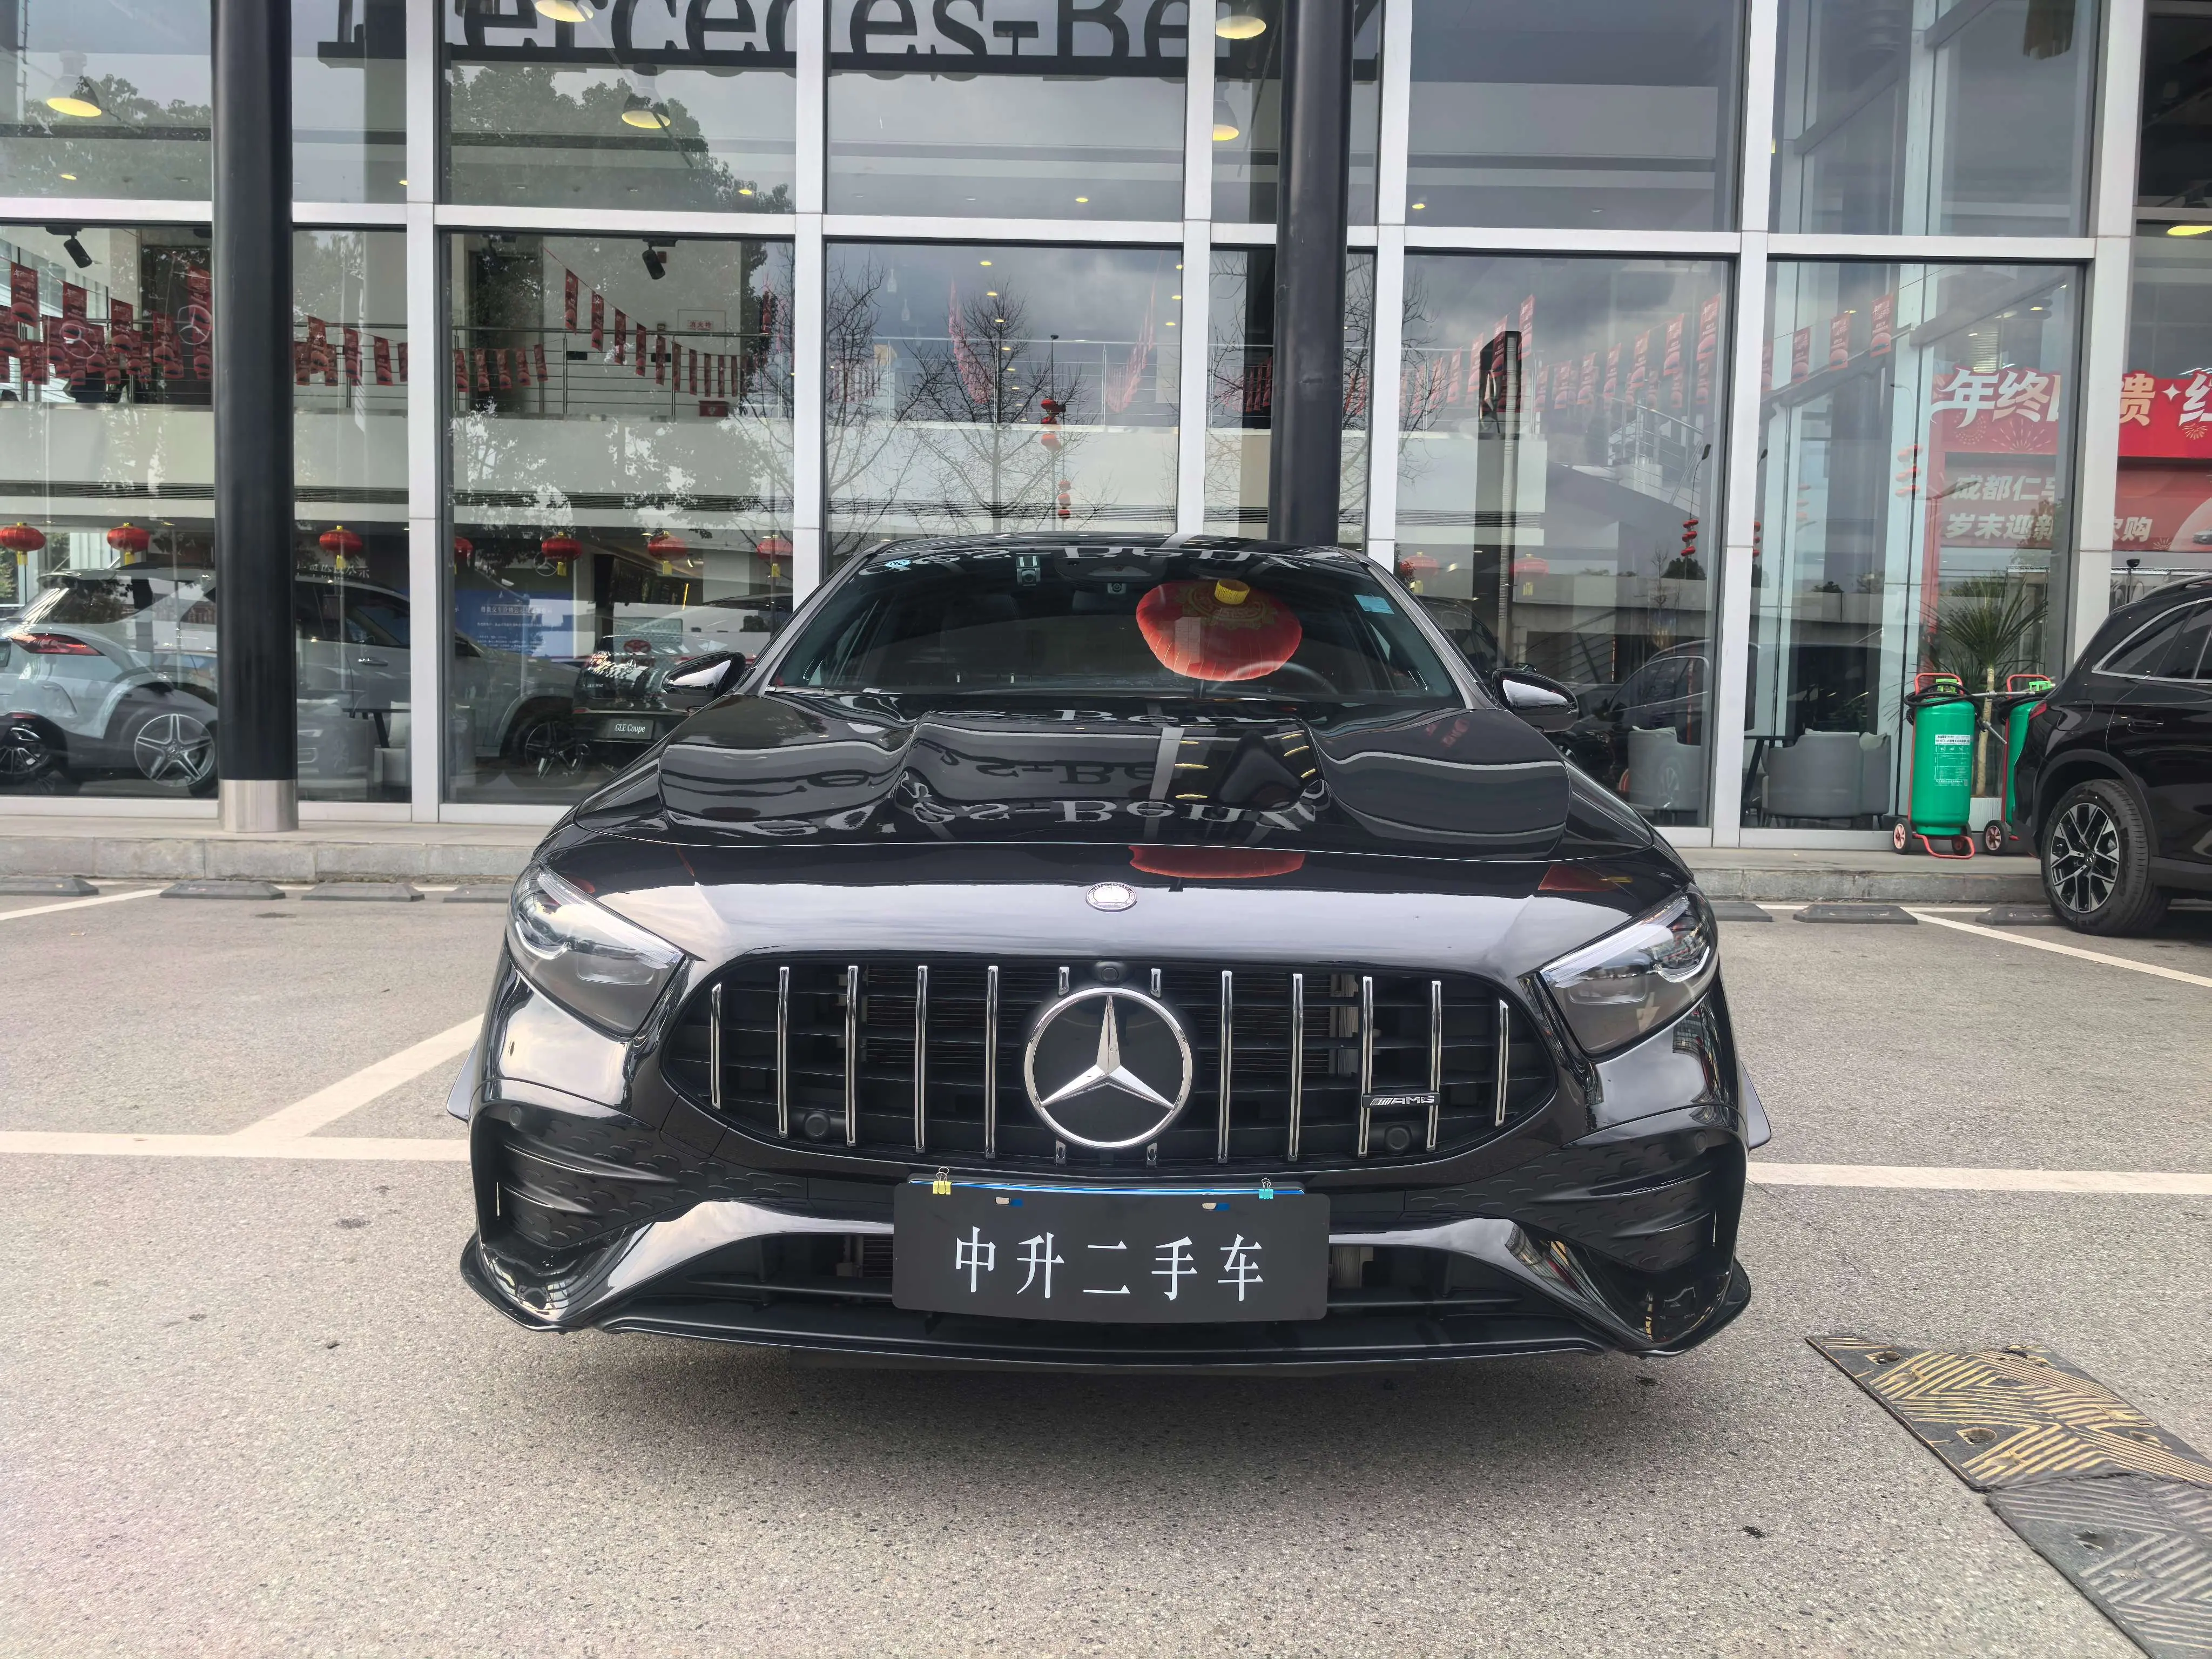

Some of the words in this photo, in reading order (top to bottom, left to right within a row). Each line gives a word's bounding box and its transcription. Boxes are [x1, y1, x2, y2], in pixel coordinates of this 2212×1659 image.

[615, 724, 626, 732] GLE
[627, 724, 645, 734] Coupe
[1391, 1096, 1435, 1105] AMG
[955, 1226, 1264, 1301] 中升二手车
